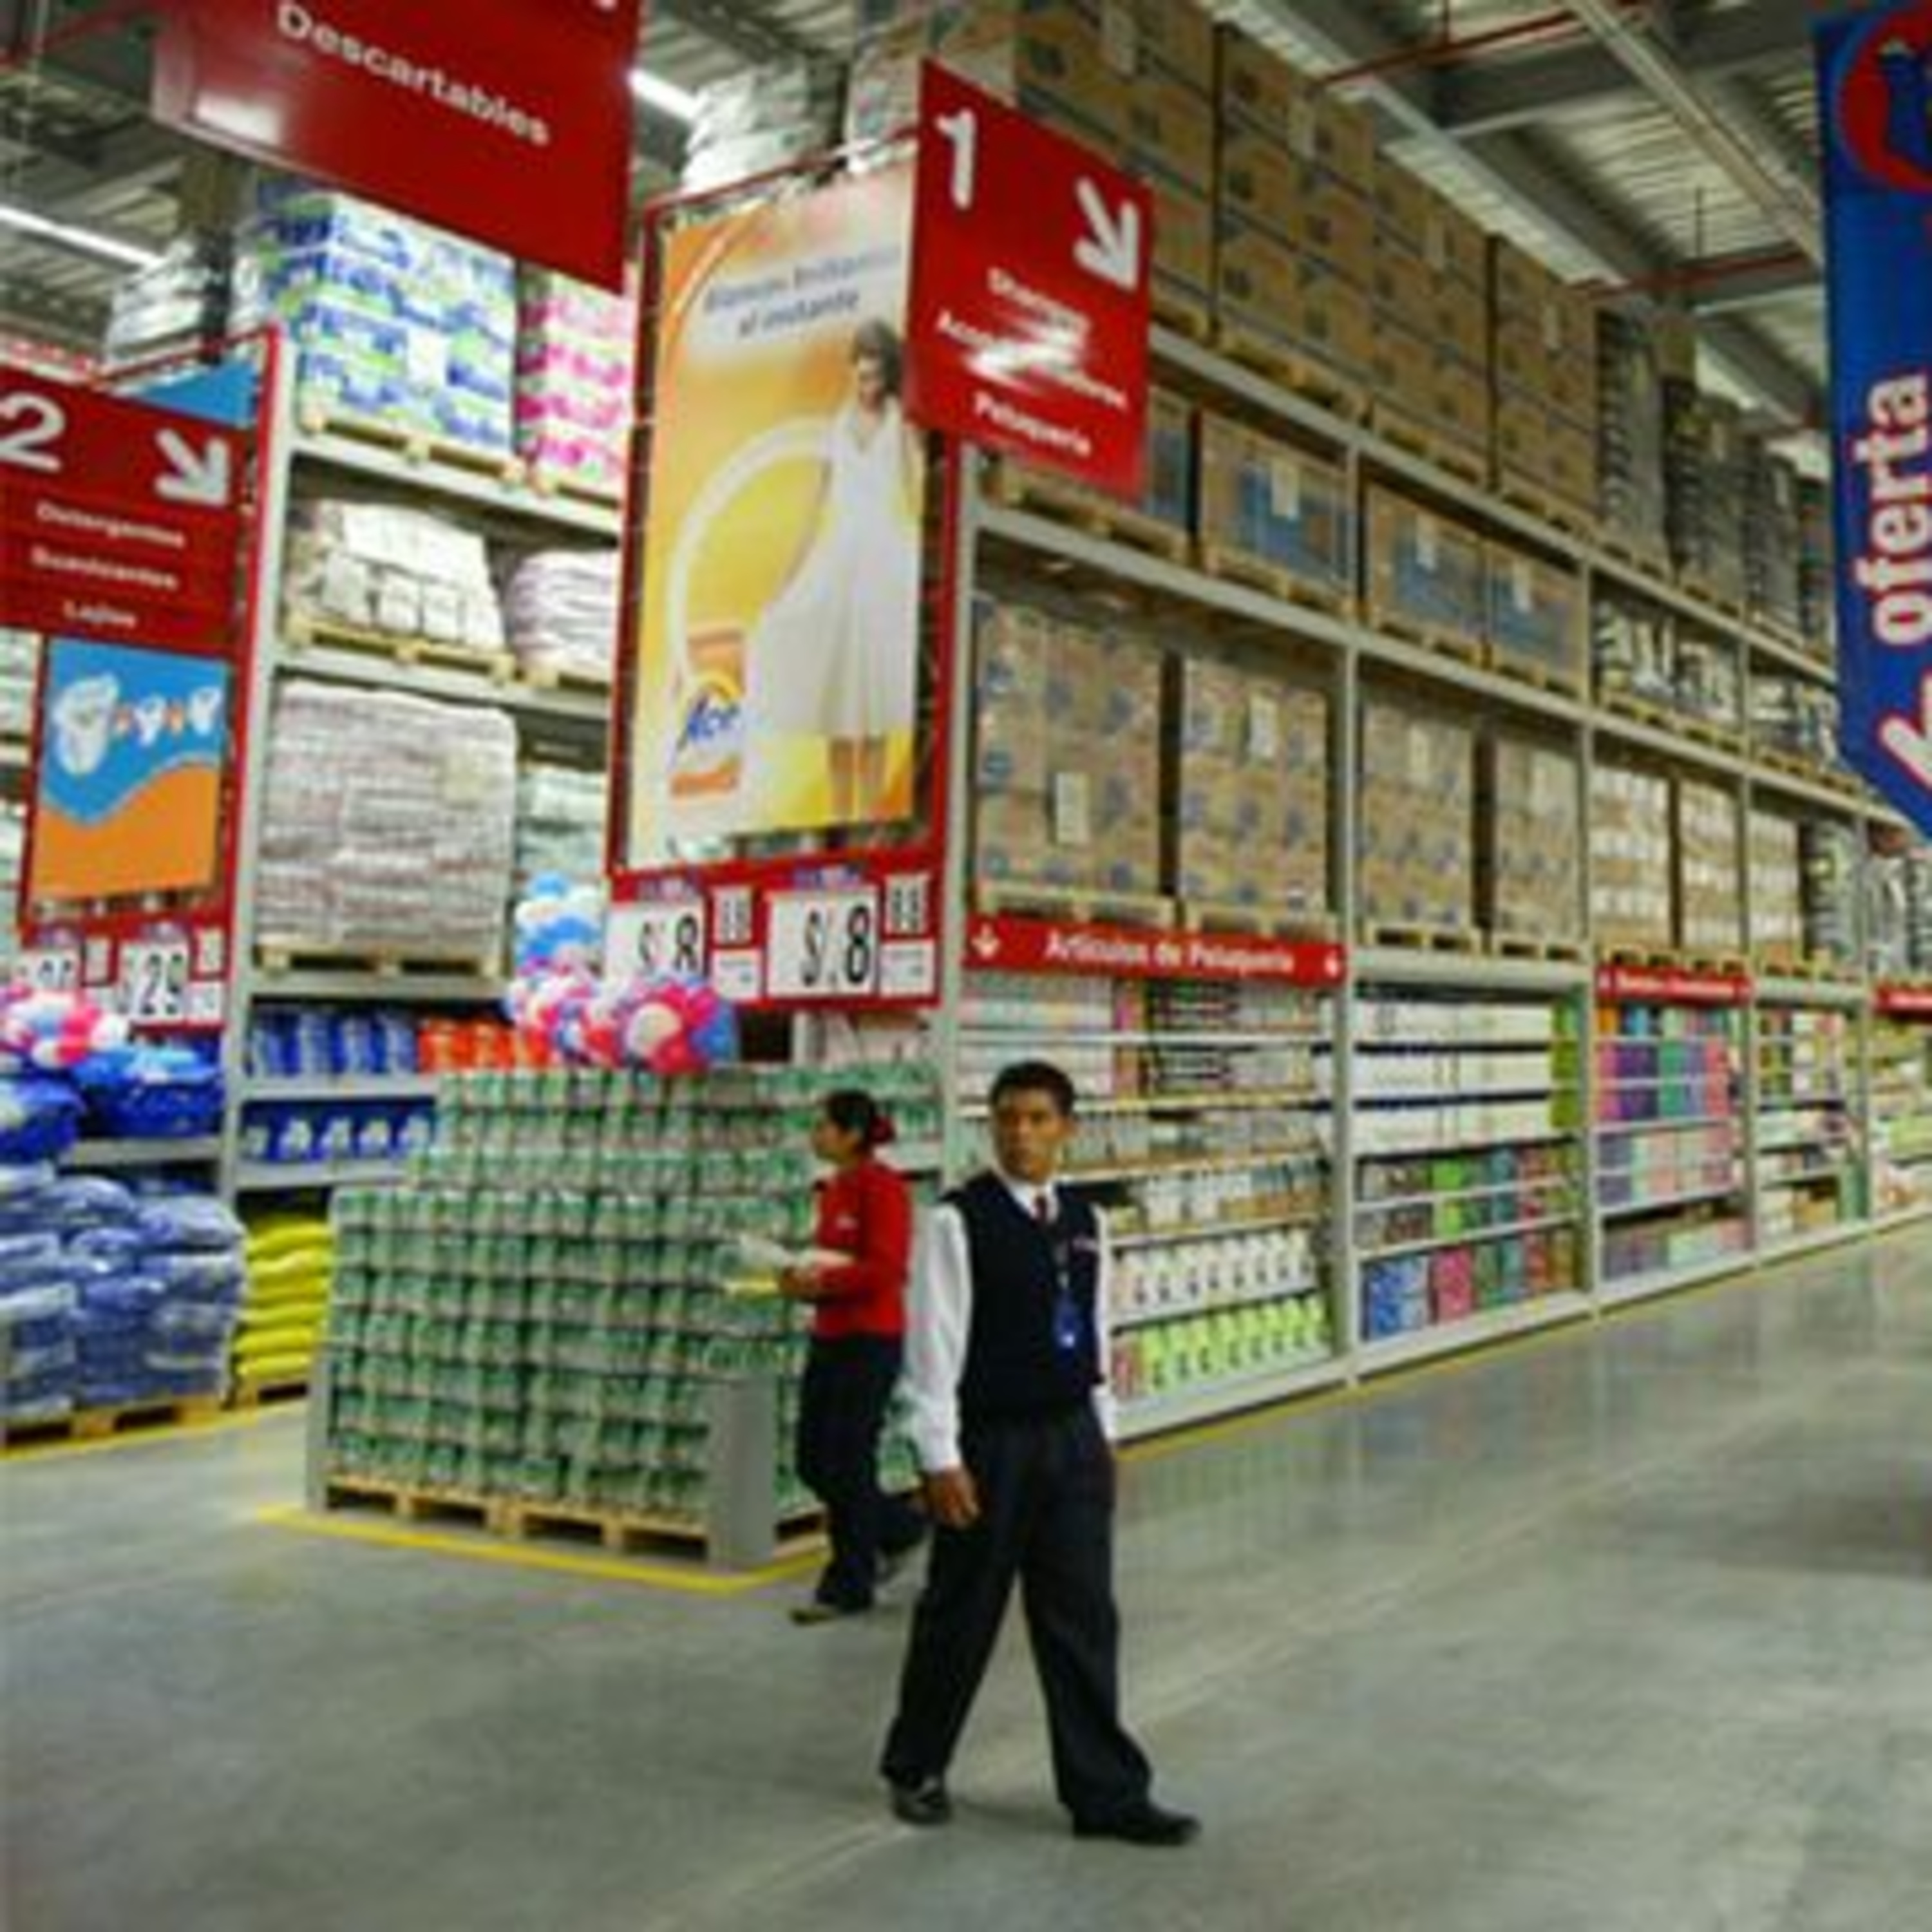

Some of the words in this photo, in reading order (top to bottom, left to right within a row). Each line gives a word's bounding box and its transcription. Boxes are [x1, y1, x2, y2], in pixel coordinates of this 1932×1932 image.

[278, 1, 551, 147] Descartables
[936, 108, 976, 210] 1
[0, 392, 66, 473] 2
[1853, 374, 1932, 645] oferta
